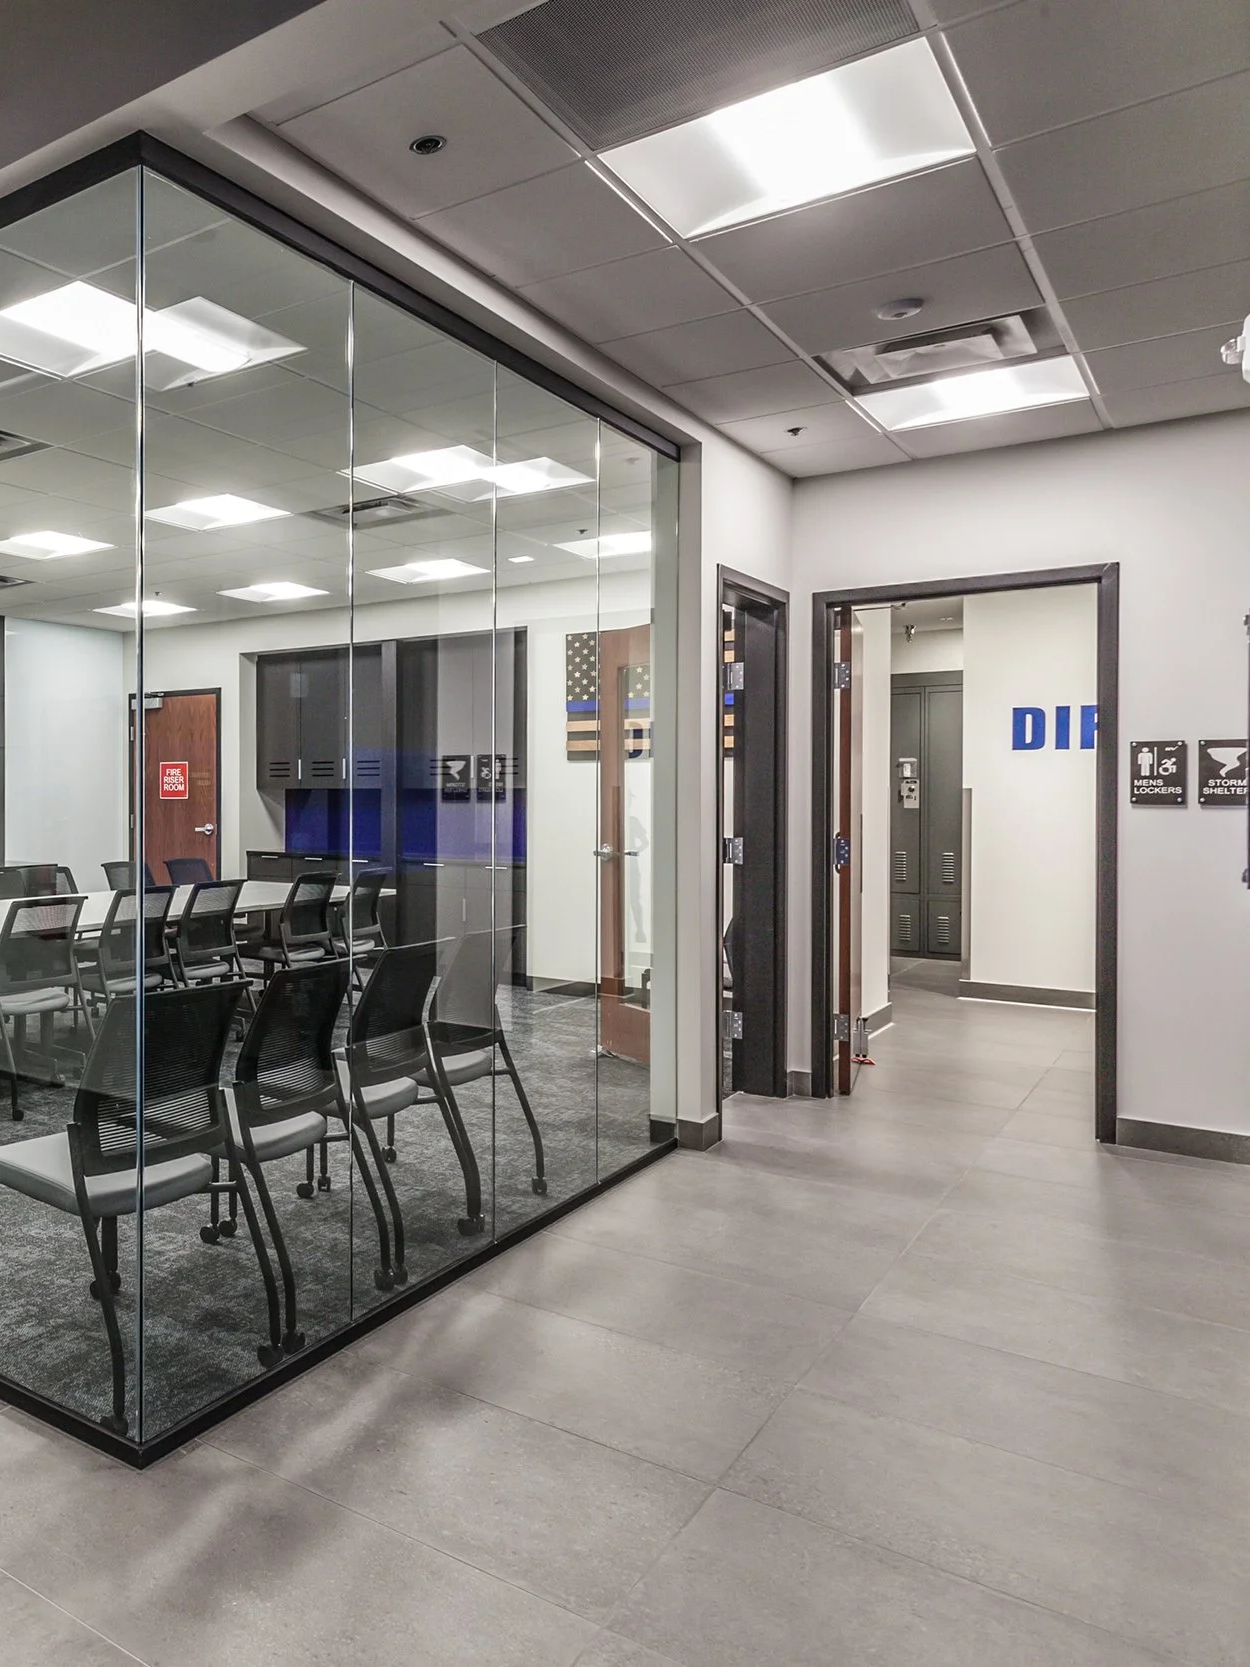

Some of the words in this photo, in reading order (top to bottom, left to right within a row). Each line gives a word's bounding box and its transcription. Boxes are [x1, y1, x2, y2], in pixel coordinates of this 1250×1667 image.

[166, 768, 182, 776] FIRE
[163, 776, 185, 784] RISER
[1133, 779, 1164, 787] MENS
[163, 784, 185, 792] ROOM
[1133, 787, 1183, 795] LOCKERS
